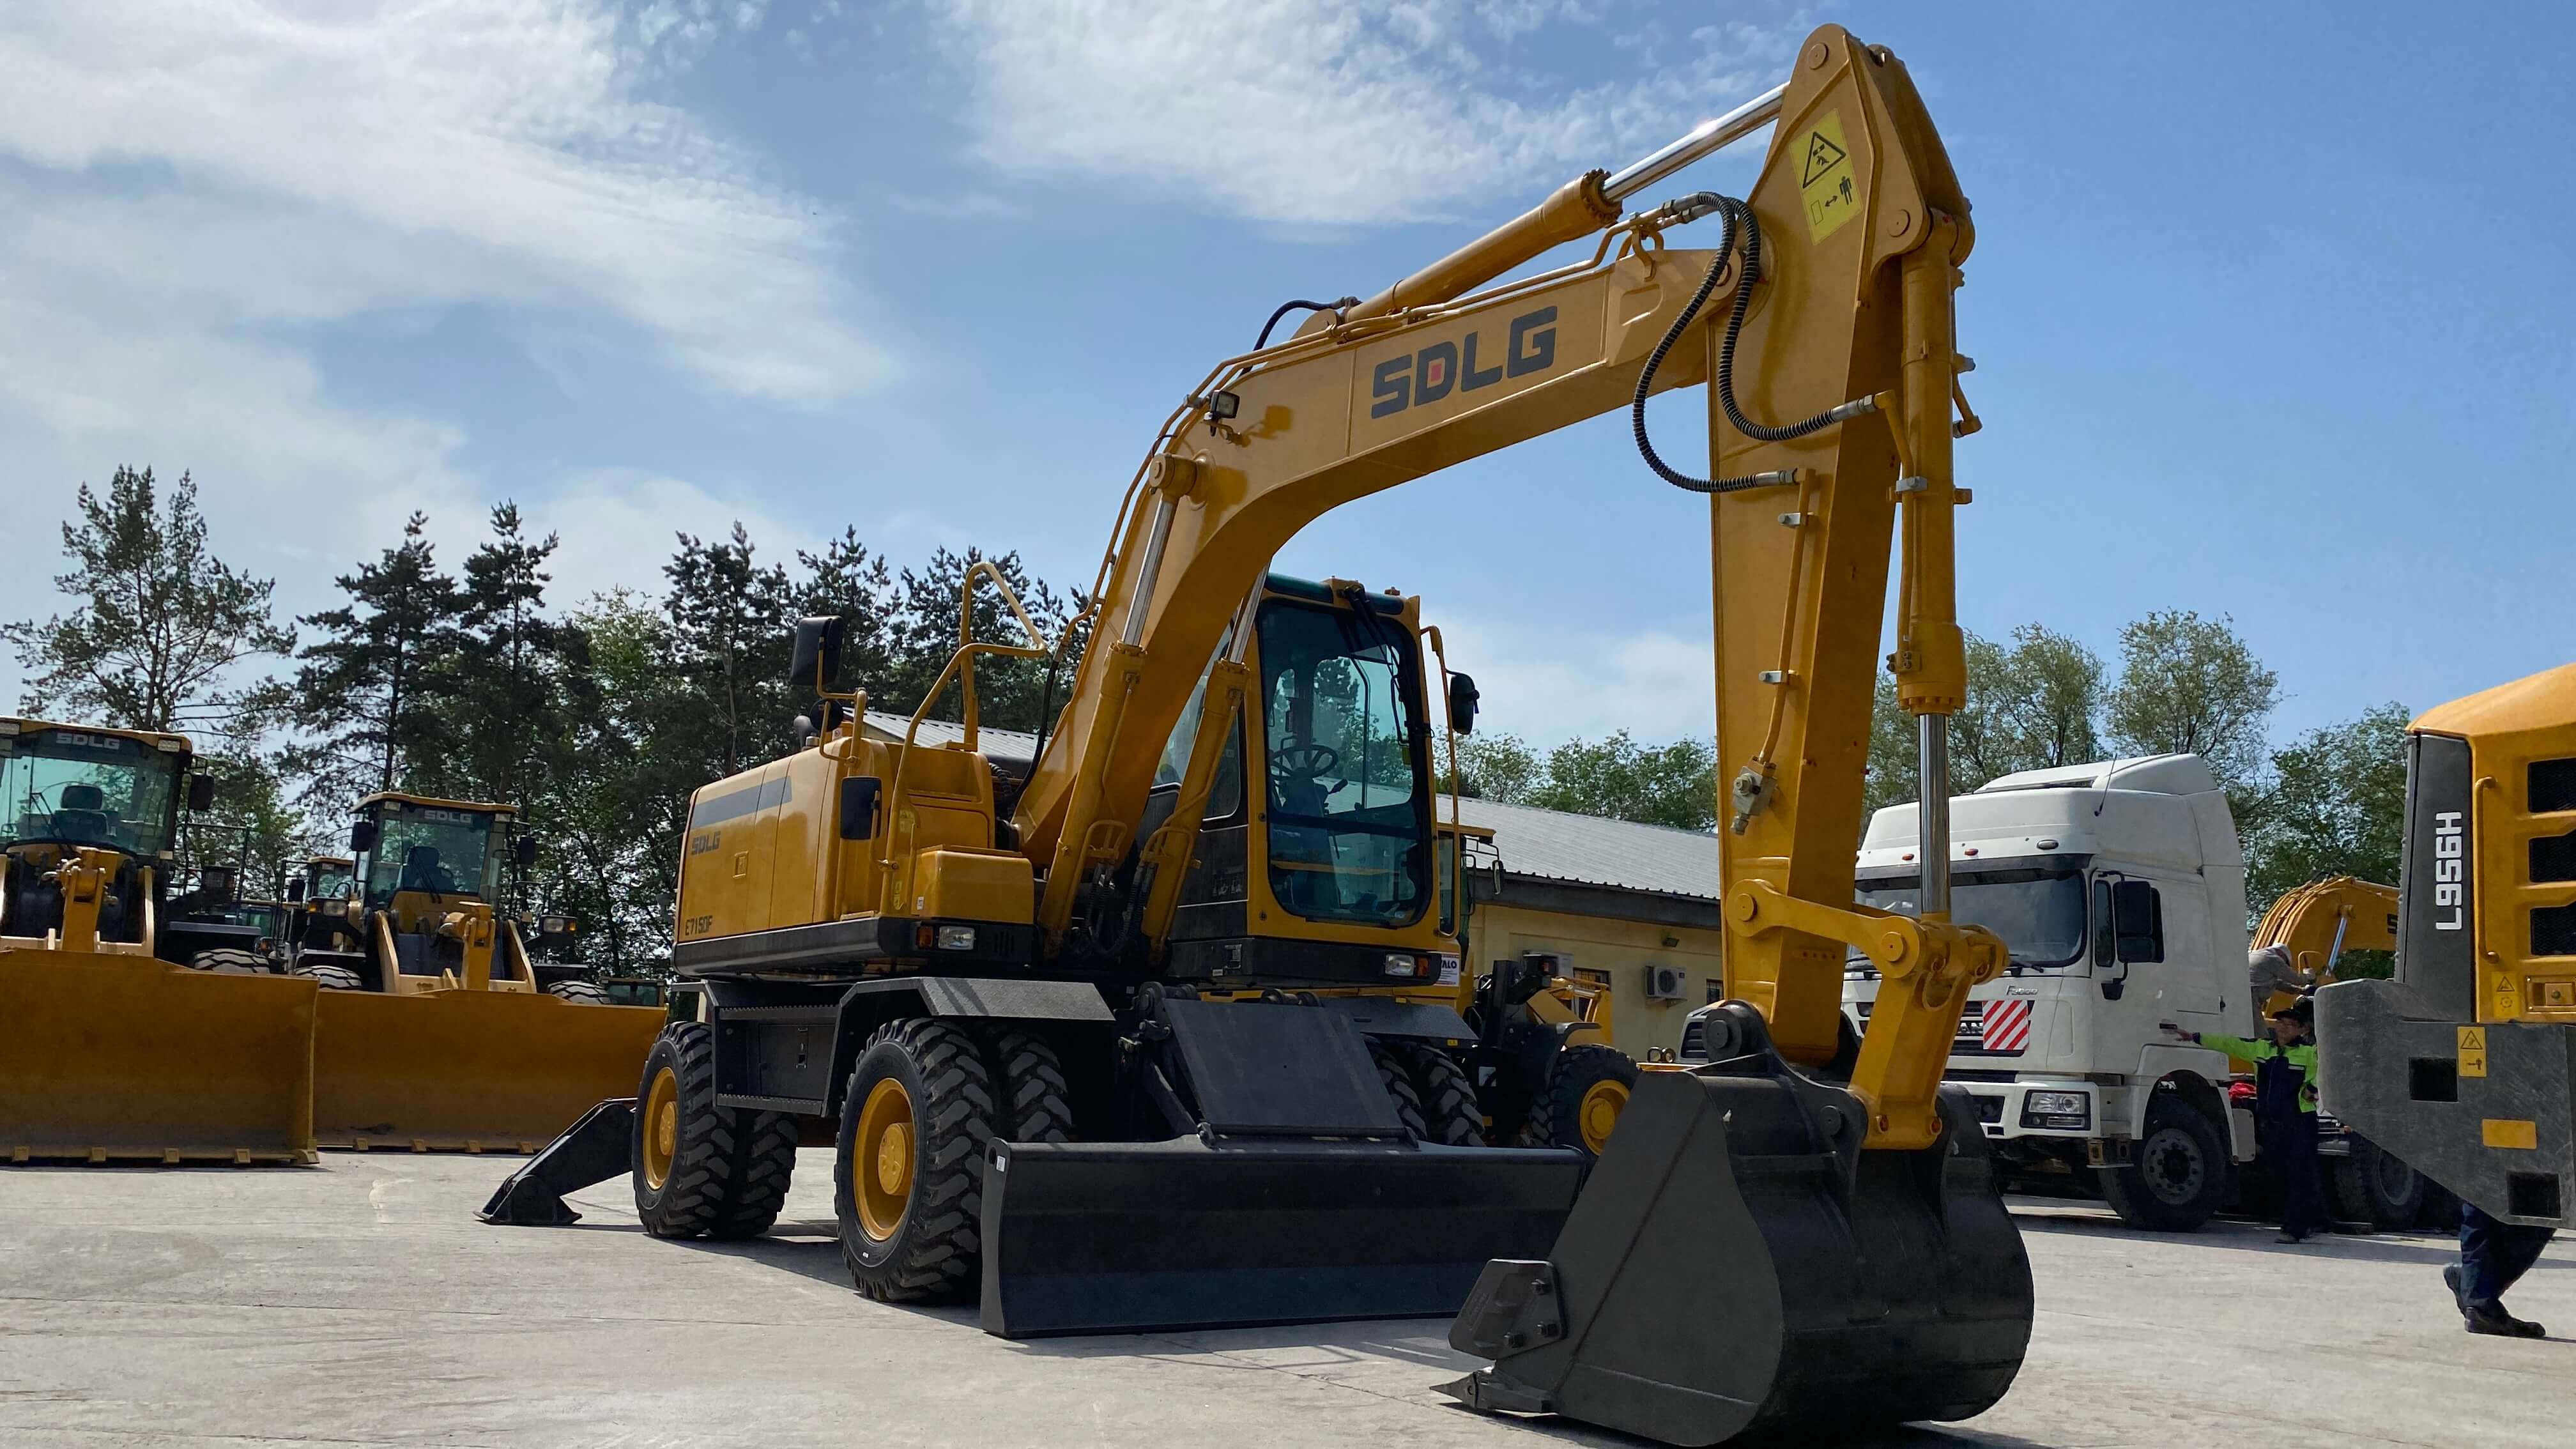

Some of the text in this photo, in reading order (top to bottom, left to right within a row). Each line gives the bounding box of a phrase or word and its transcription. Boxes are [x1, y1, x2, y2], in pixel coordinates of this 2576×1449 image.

[1371, 305, 1558, 419] SDLG
[56, 732, 121, 750] SDLG
[424, 809, 472, 824] SDLG
[691, 831, 721, 855] SDLG
[2435, 811, 2462, 930] L956H
[1441, 960, 1457, 969] ALO
